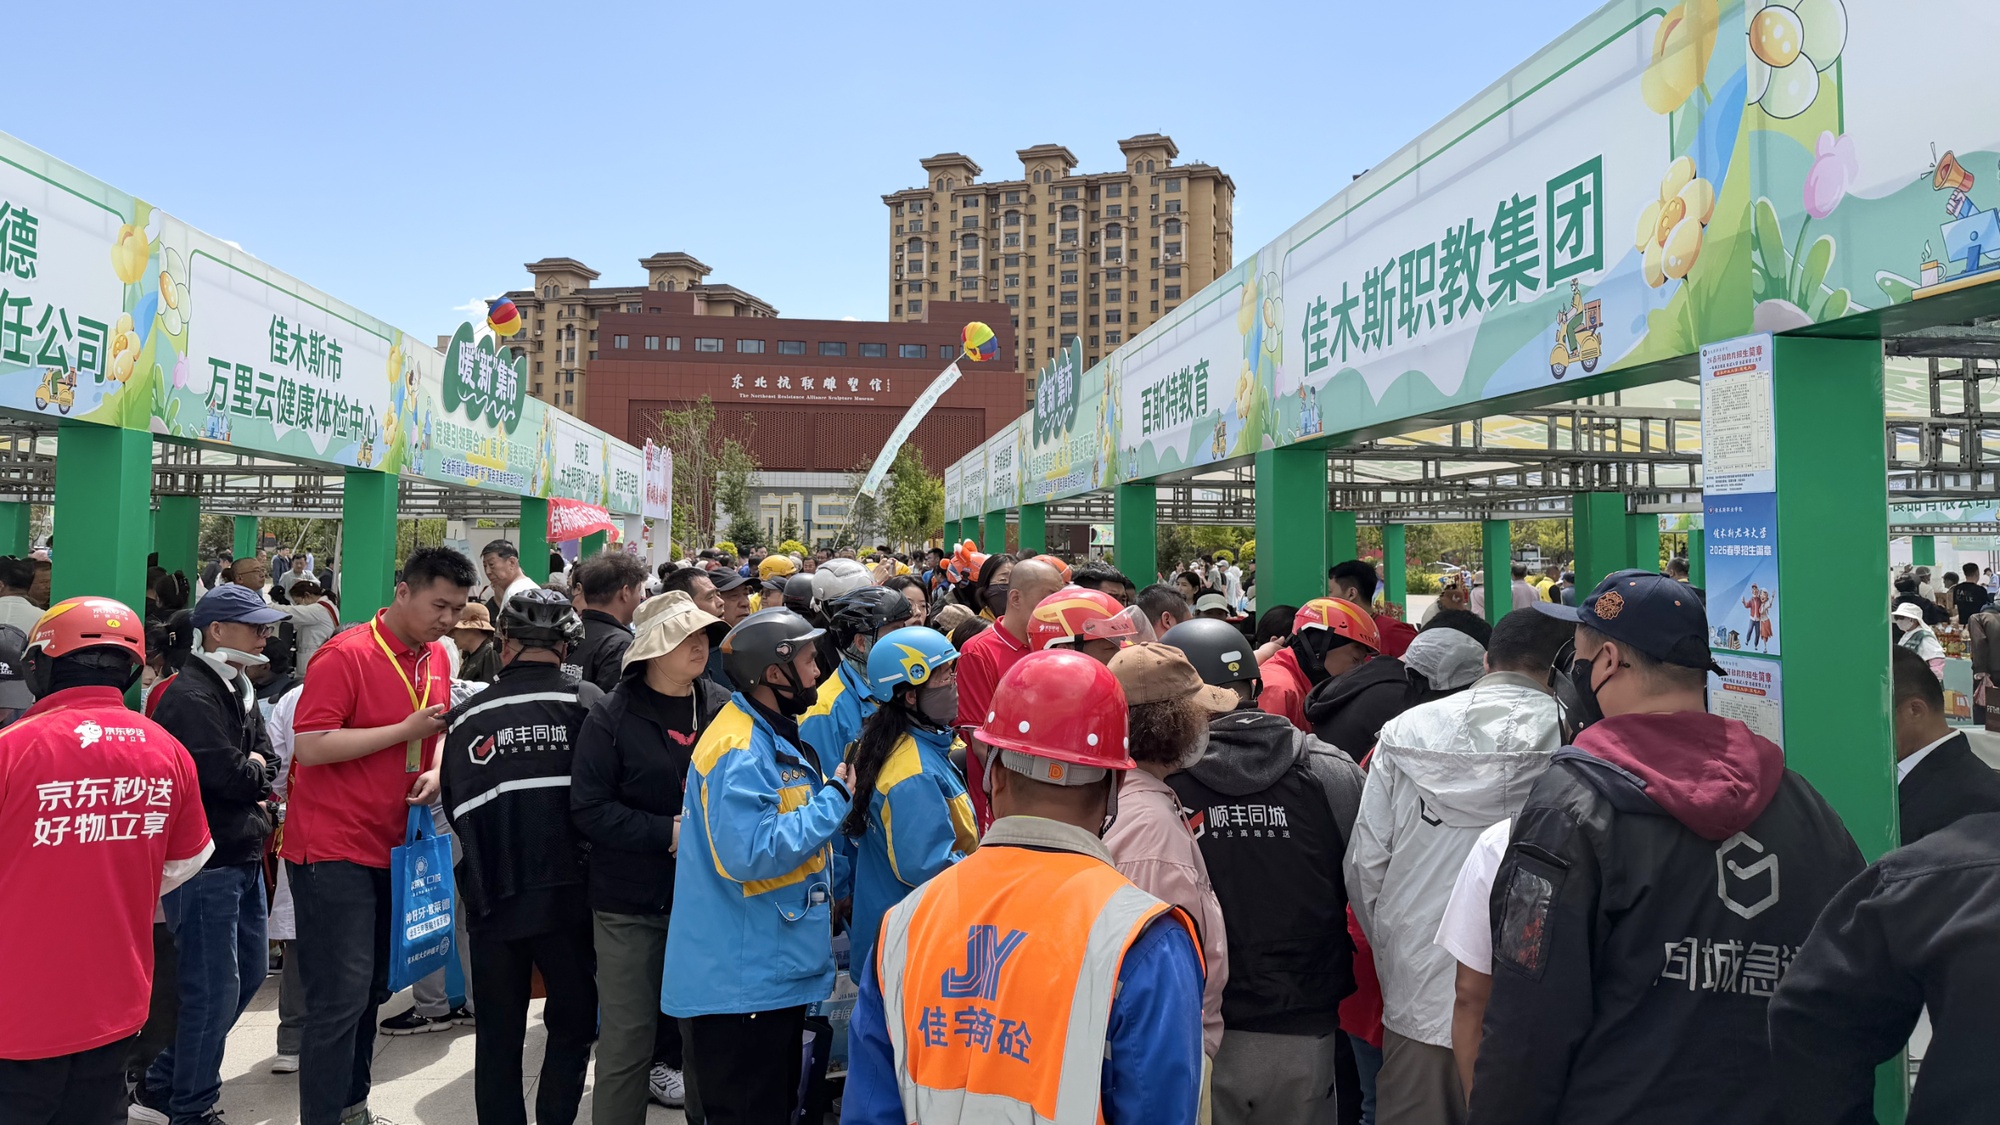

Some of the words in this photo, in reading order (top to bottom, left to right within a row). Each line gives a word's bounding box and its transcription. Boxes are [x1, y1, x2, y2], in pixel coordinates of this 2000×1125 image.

[0, 202, 39, 280] 德
[1302, 154, 1604, 377] 佳木斯职教集团
[0, 288, 109, 385] 任公司
[269, 313, 343, 382] 佳木斯市
[205, 357, 378, 445] 万里云健康体检中心
[731, 373, 882, 392] 东北抗联雕塑馆
[1141, 357, 1210, 437] 百斯特教育
[1710, 545, 1772, 556] 2026春季招生简章
[105, 727, 144, 737] 京东秒送
[497, 725, 568, 747] 顺丰同城
[499, 744, 571, 755] 专业高端急送
[36, 776, 174, 812] 京东秒送
[32, 811, 170, 848] 好物立享
[1208, 804, 1289, 828] 顺丰同城
[1211, 829, 1291, 839] 专业高端急送
[941, 924, 1029, 1002] JY
[918, 1005, 1033, 1064] 佳宇商砼
